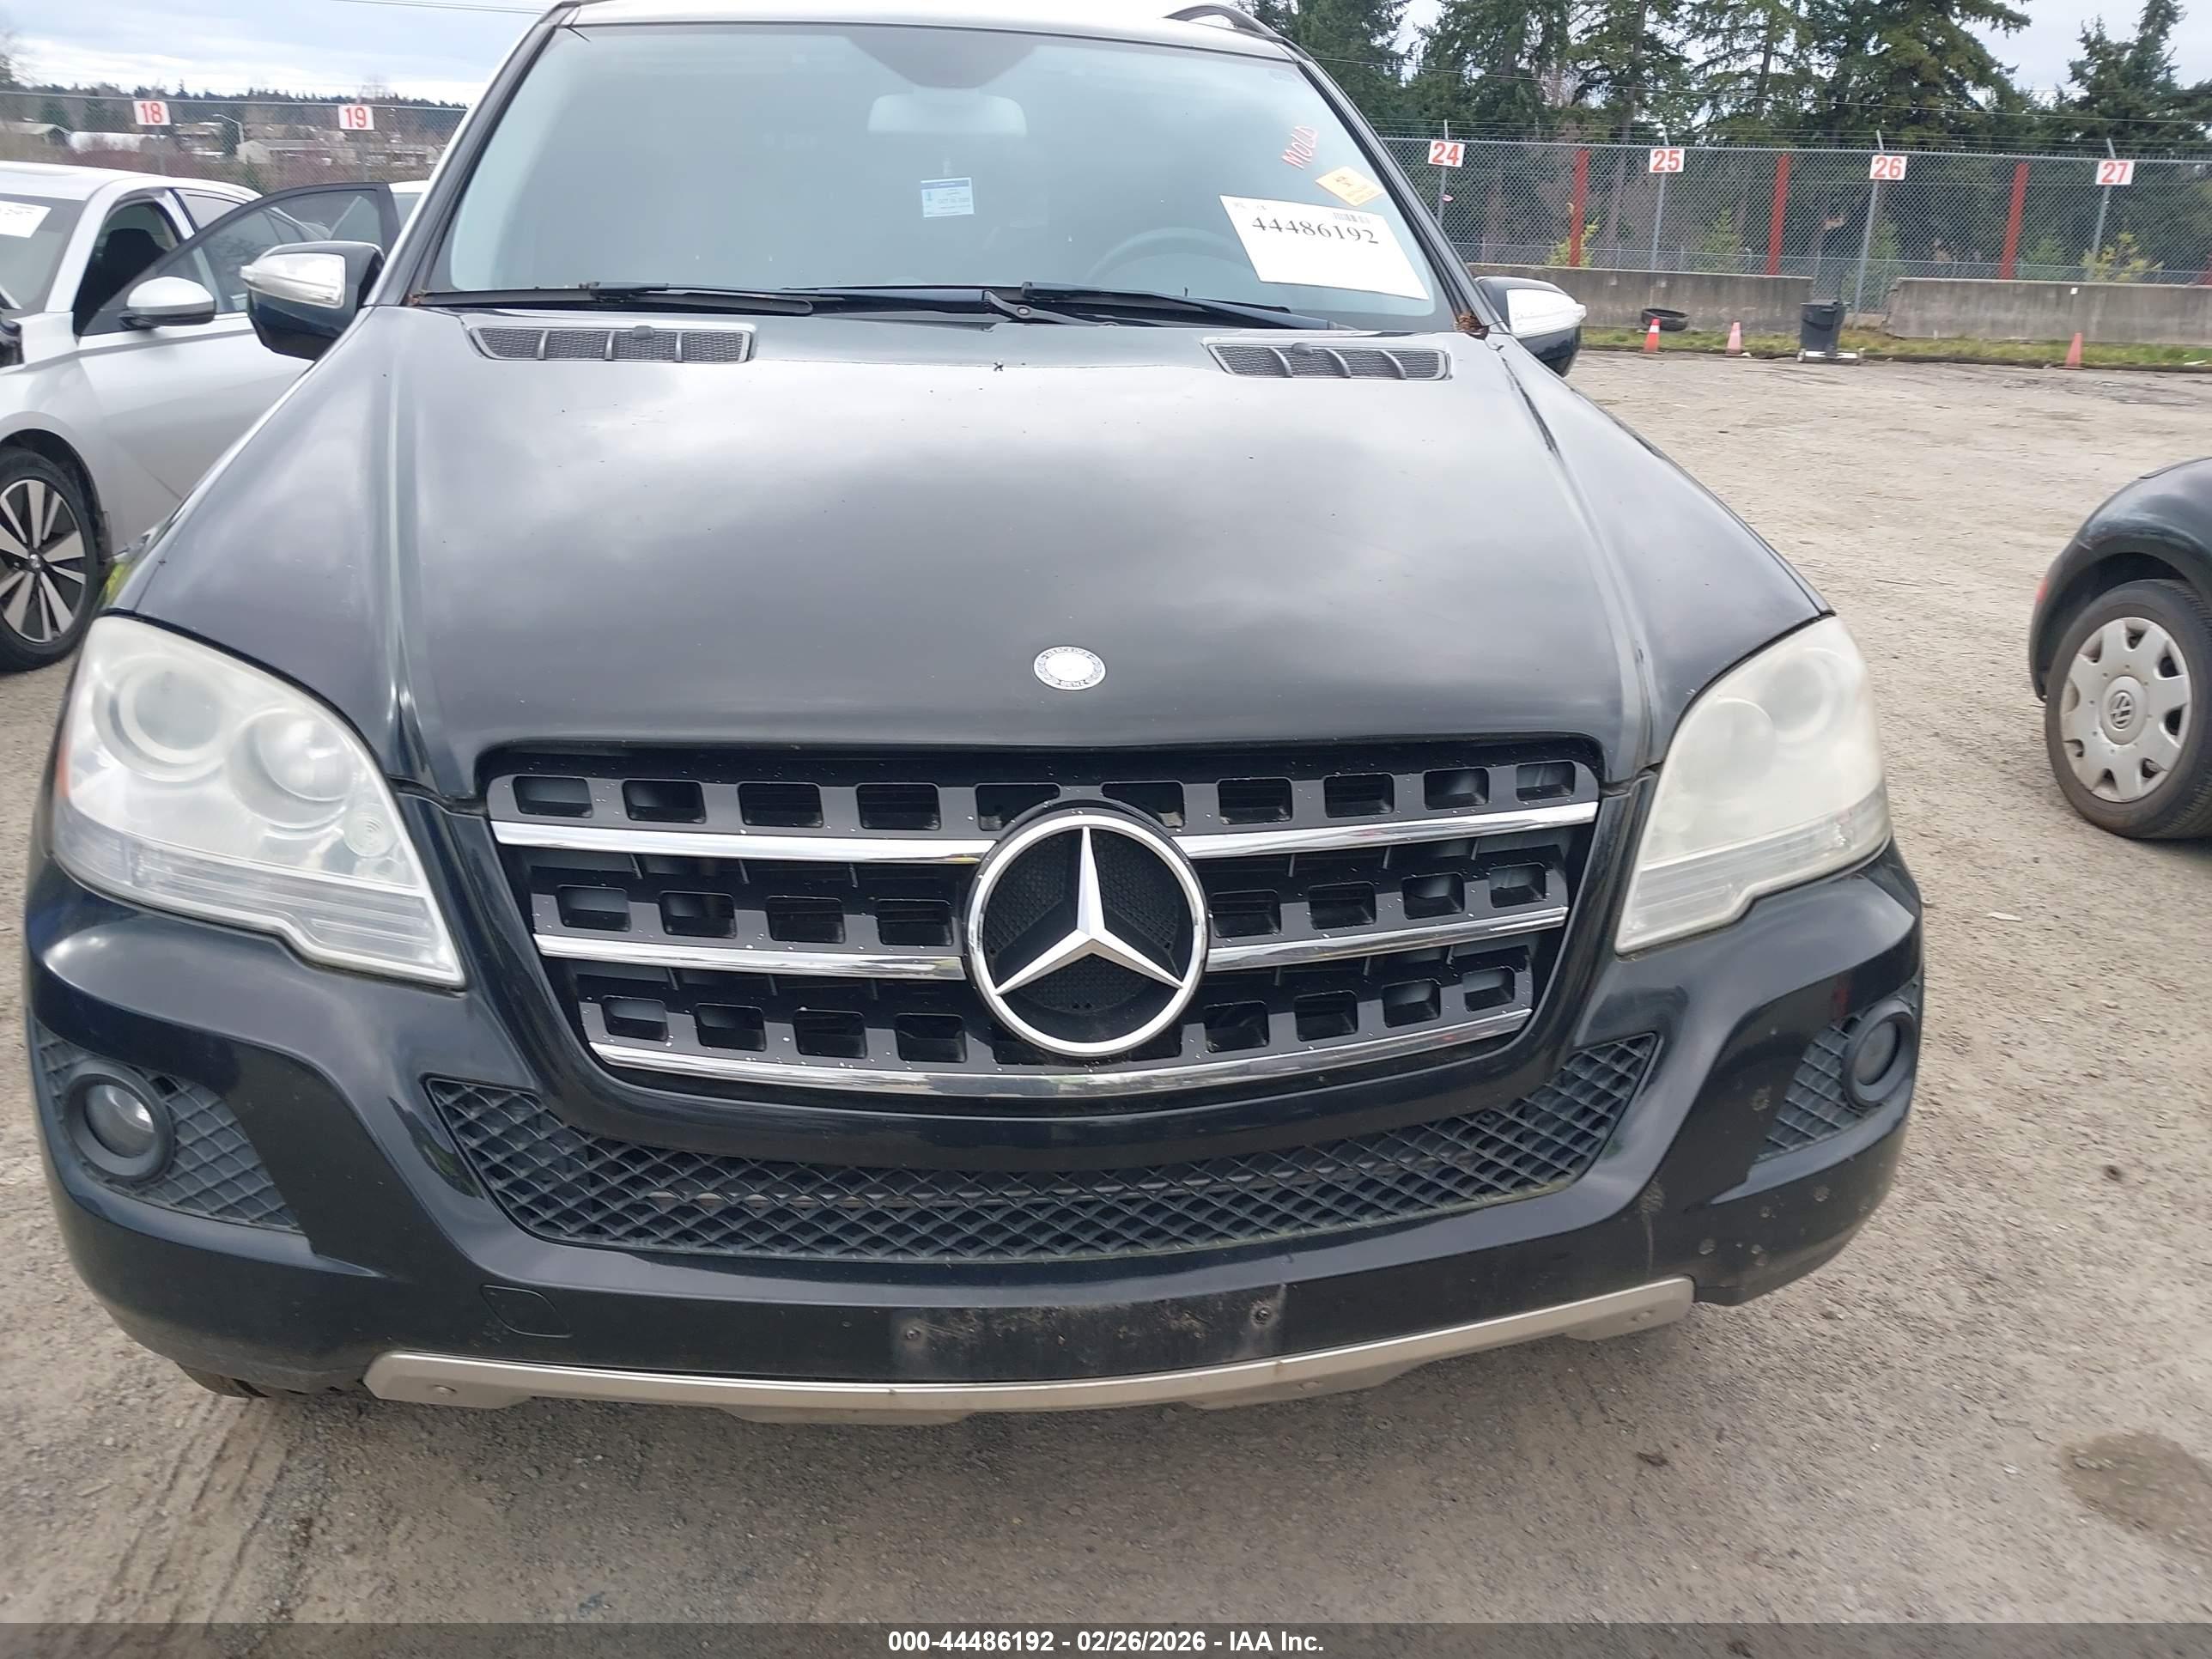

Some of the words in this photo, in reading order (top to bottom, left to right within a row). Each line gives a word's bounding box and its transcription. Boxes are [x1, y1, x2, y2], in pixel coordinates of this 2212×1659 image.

[140, 102, 162, 124] 18
[345, 106, 366, 128] 19
[1431, 142, 1460, 165] 24
[1652, 149, 1680, 171] 25
[1874, 156, 1902, 179] 26
[2101, 161, 2129, 183] 27
[1251, 216, 1379, 245] 44486192
